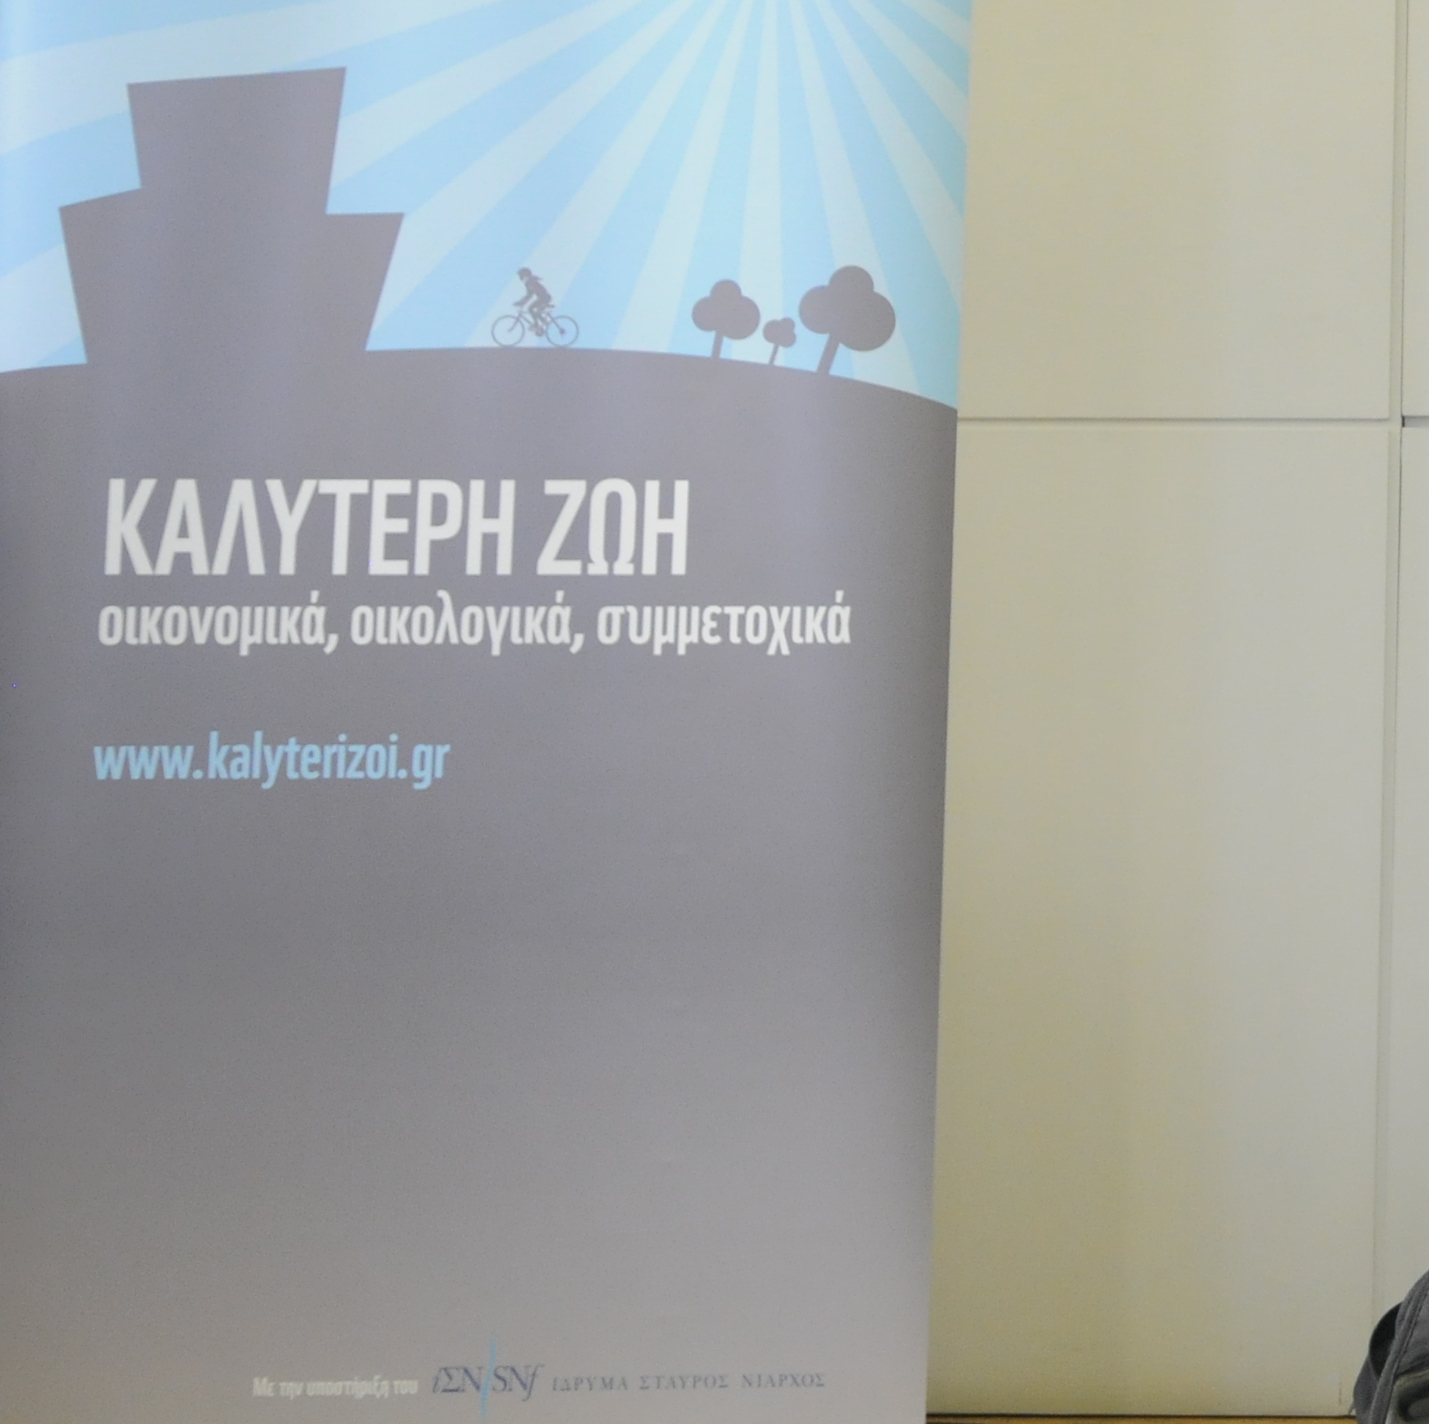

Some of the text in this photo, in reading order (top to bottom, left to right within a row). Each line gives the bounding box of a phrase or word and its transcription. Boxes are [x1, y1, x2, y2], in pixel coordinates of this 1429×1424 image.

[104, 477, 690, 576] ΚΑΛΥΤΕΡΗ ΖΩΗ
[97, 591, 852, 657] οικονομικά, οικολογικά, συμμετοχικά
[94, 731, 450, 790] www.kalyterizoi.gr
[252, 1375, 419, 1399] Με την υποστήριξη του
[551, 1371, 827, 1393] ΙΔΡΥΜΑ ΣΤΑΥΡΟΣ ΝΙΑΡΧΟΣ
